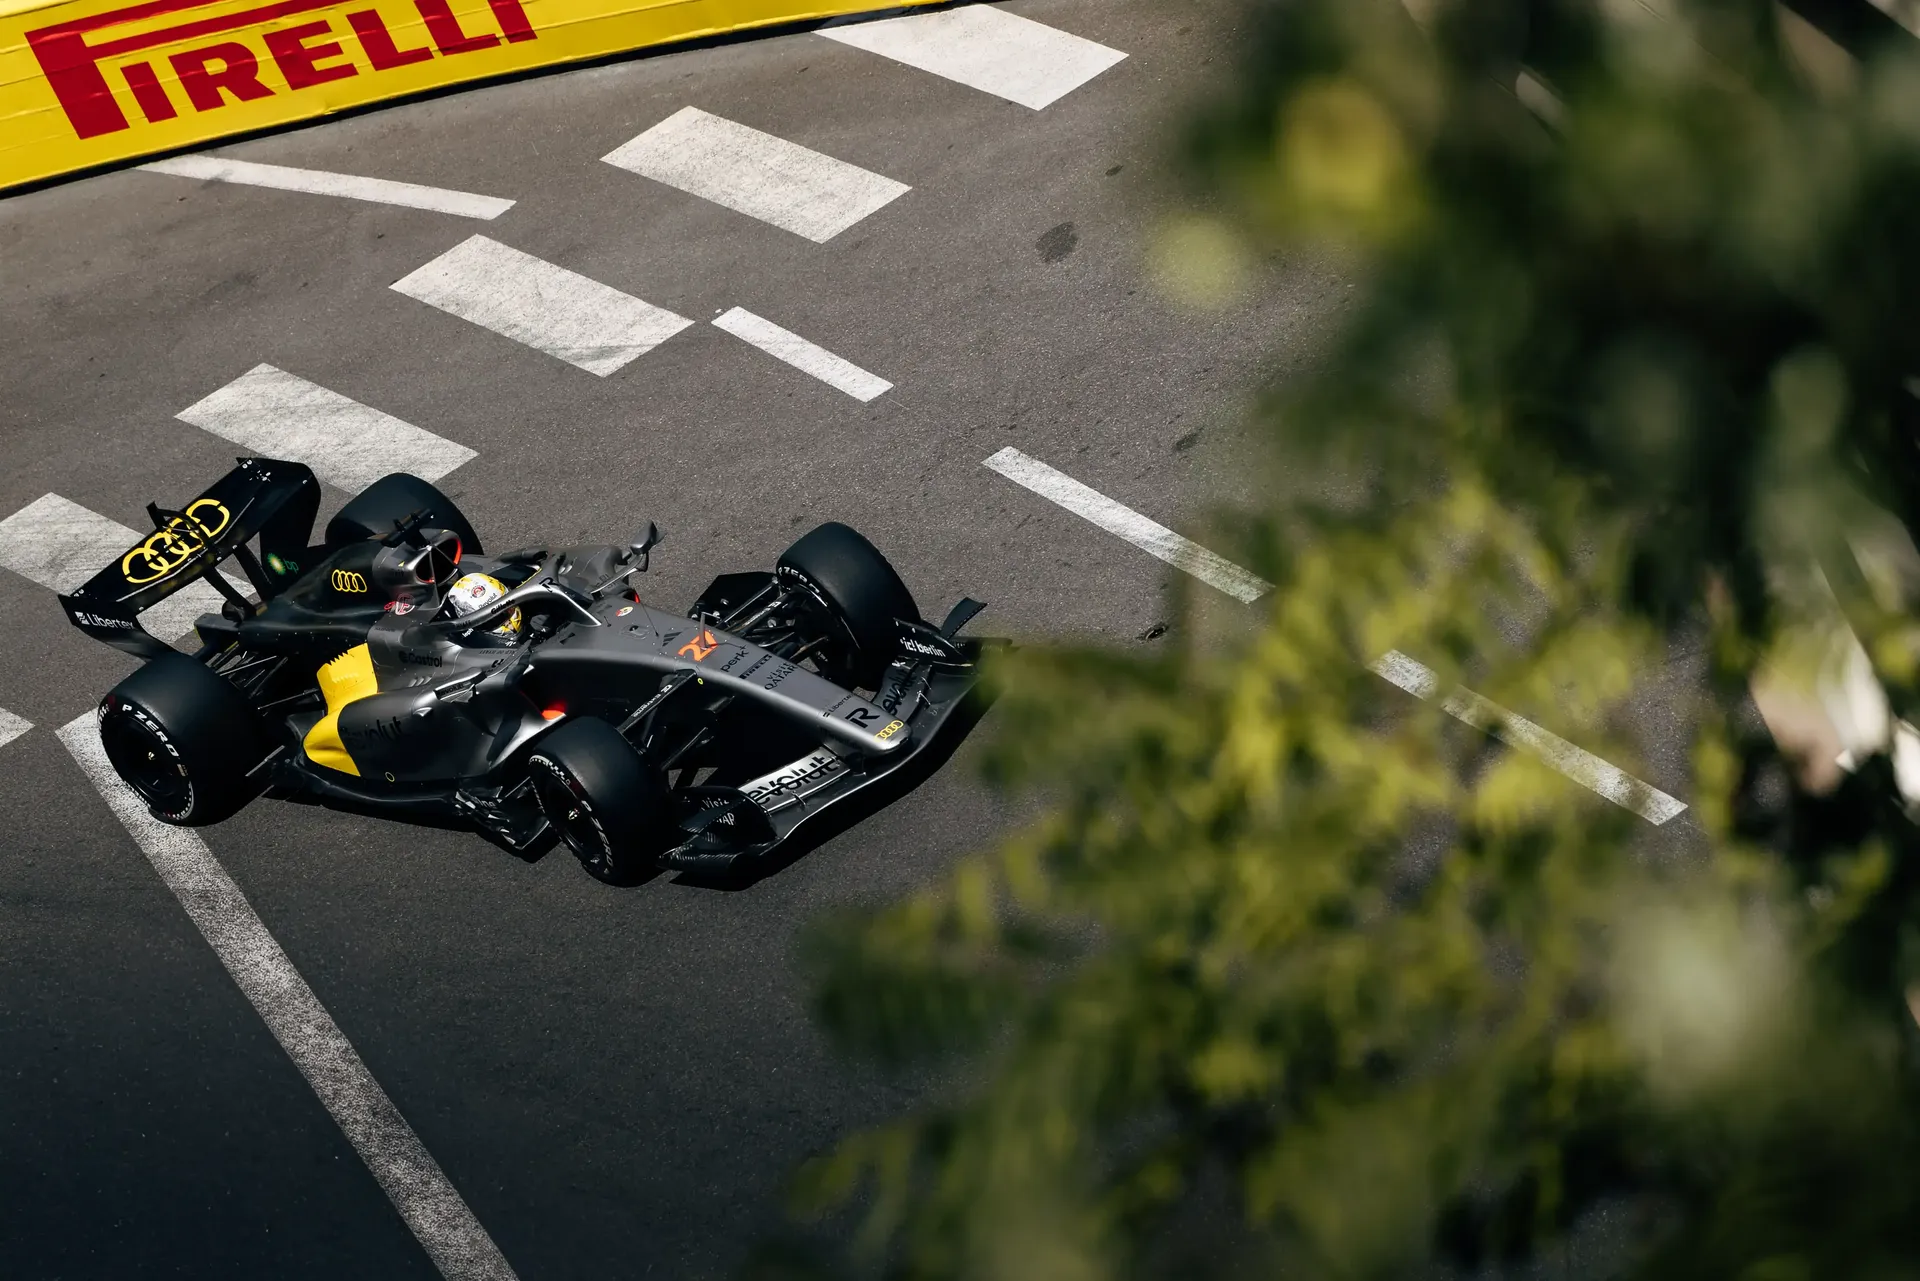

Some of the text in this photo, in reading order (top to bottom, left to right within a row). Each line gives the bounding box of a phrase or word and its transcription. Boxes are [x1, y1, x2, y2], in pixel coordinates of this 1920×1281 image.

[23, 0, 538, 141] PIRELLI
[283, 558, 300, 575] bp
[86, 612, 136, 630] Libertex
[408, 651, 443, 668] Castrol
[914, 640, 947, 657] berlin
[764, 665, 798, 691] QATAR
[845, 707, 881, 730] R
[134, 710, 181, 758] ZERO
[747, 756, 839, 806] evolut
